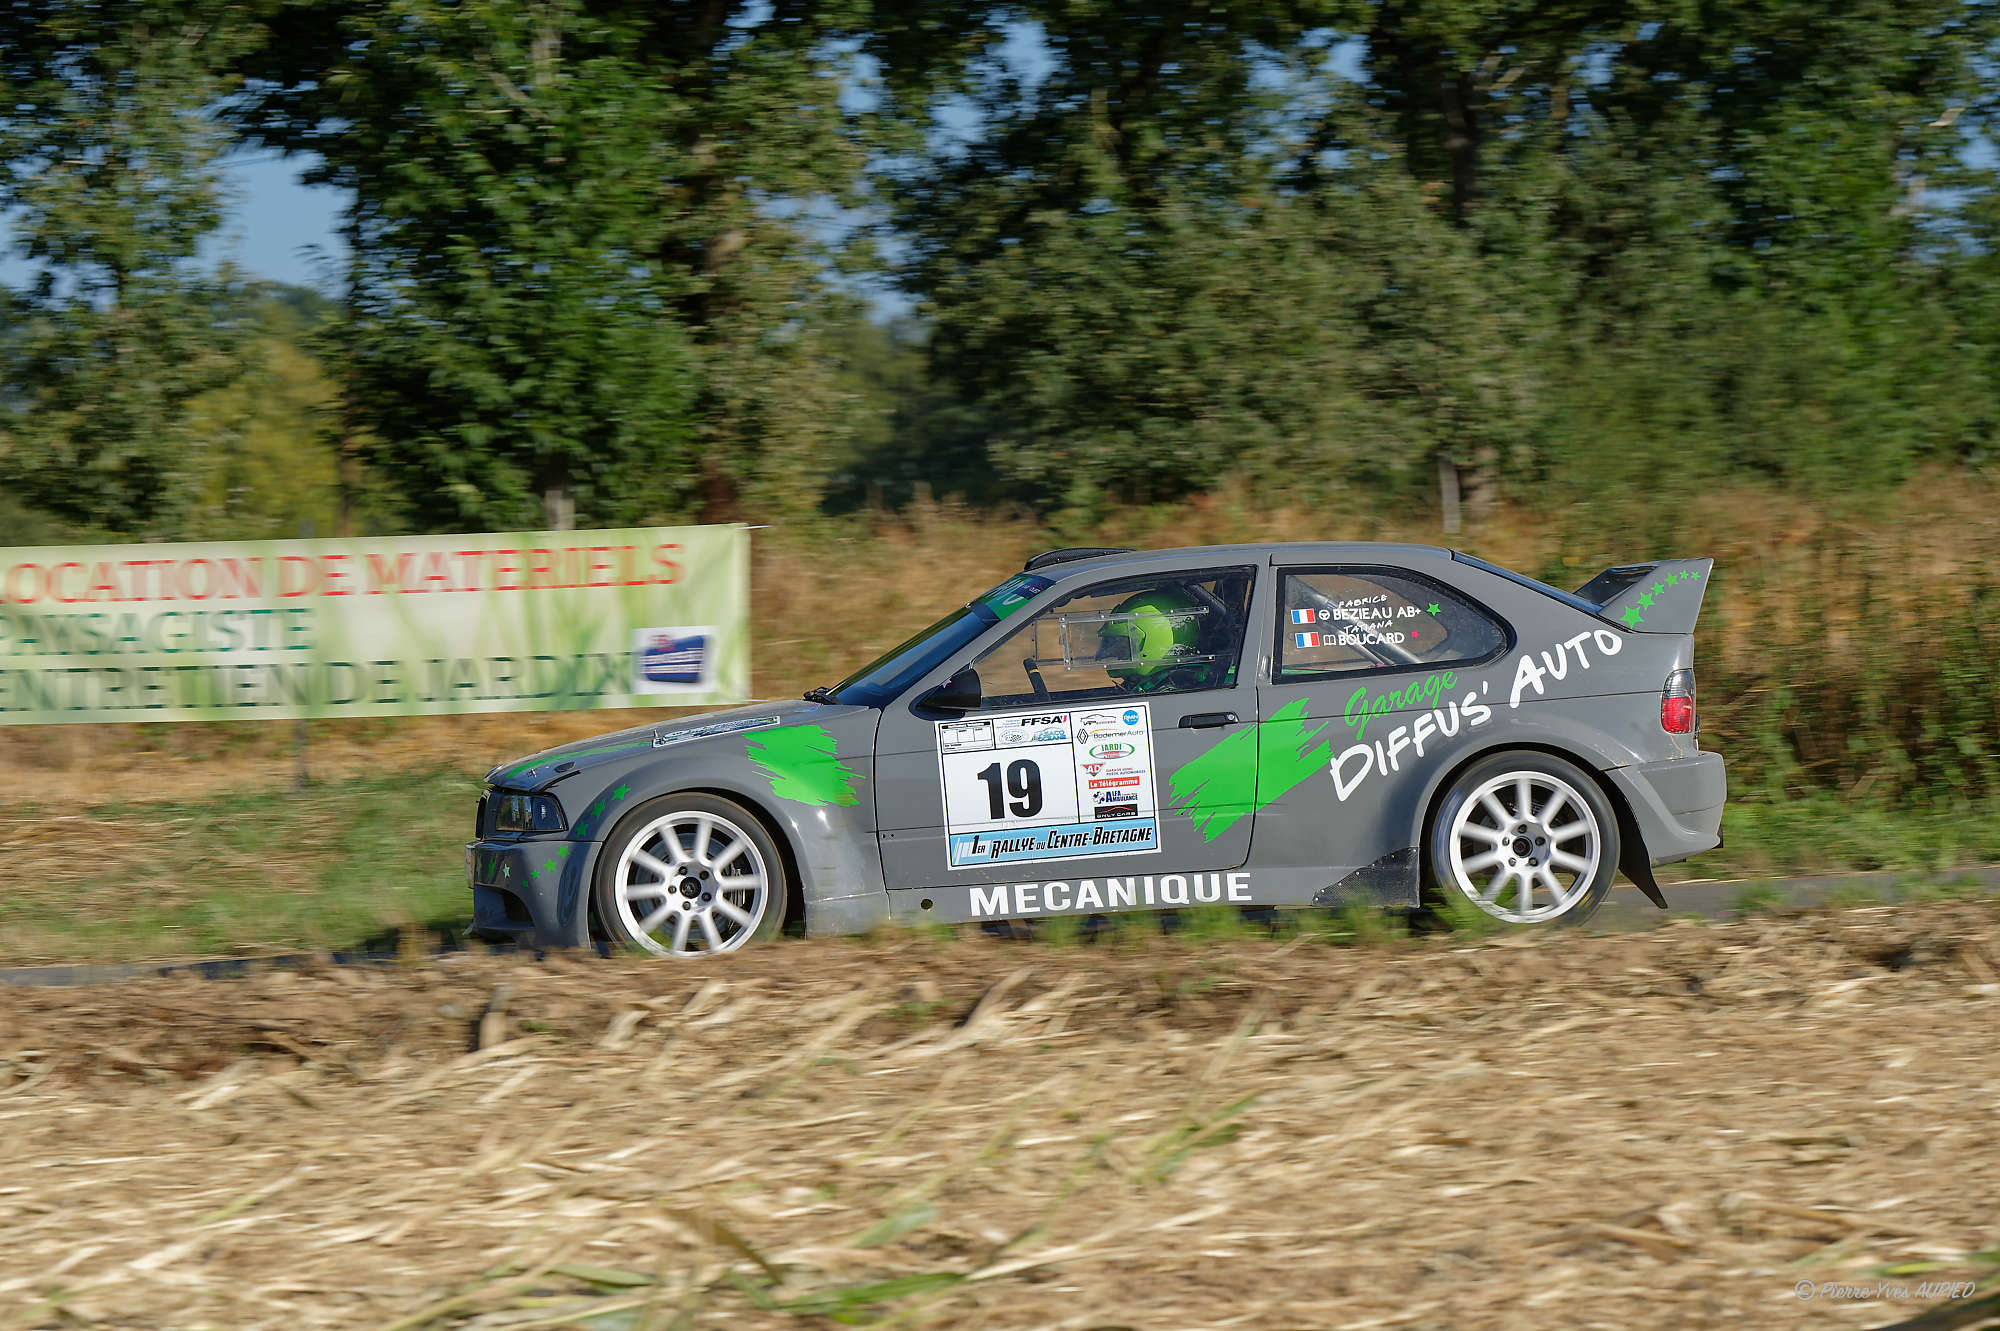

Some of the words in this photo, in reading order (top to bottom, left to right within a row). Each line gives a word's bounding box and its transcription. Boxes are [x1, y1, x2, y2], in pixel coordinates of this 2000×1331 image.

[0, 557, 263, 604] OCATION
[276, 554, 354, 597] DE
[364, 543, 686, 595] MATERIELS
[1333, 606, 1393, 620] BEZIEAU
[1397, 606, 1421, 618] AB+
[1344, 620, 1393, 634] TATIANA
[1338, 632, 1405, 646] BOUCARD
[0, 664, 313, 711] NTRETIEN
[325, 660, 400, 705] DE
[1344, 671, 1457, 740] Garage
[1021, 715, 1063, 726] FFSA
[1330, 681, 1491, 802] DIFFUS'
[1509, 629, 1622, 709] AUTO
[977, 759, 1043, 819] 19
[991, 837, 1035, 859] RALLYE
[969, 872, 1252, 917] MECANIQUE
